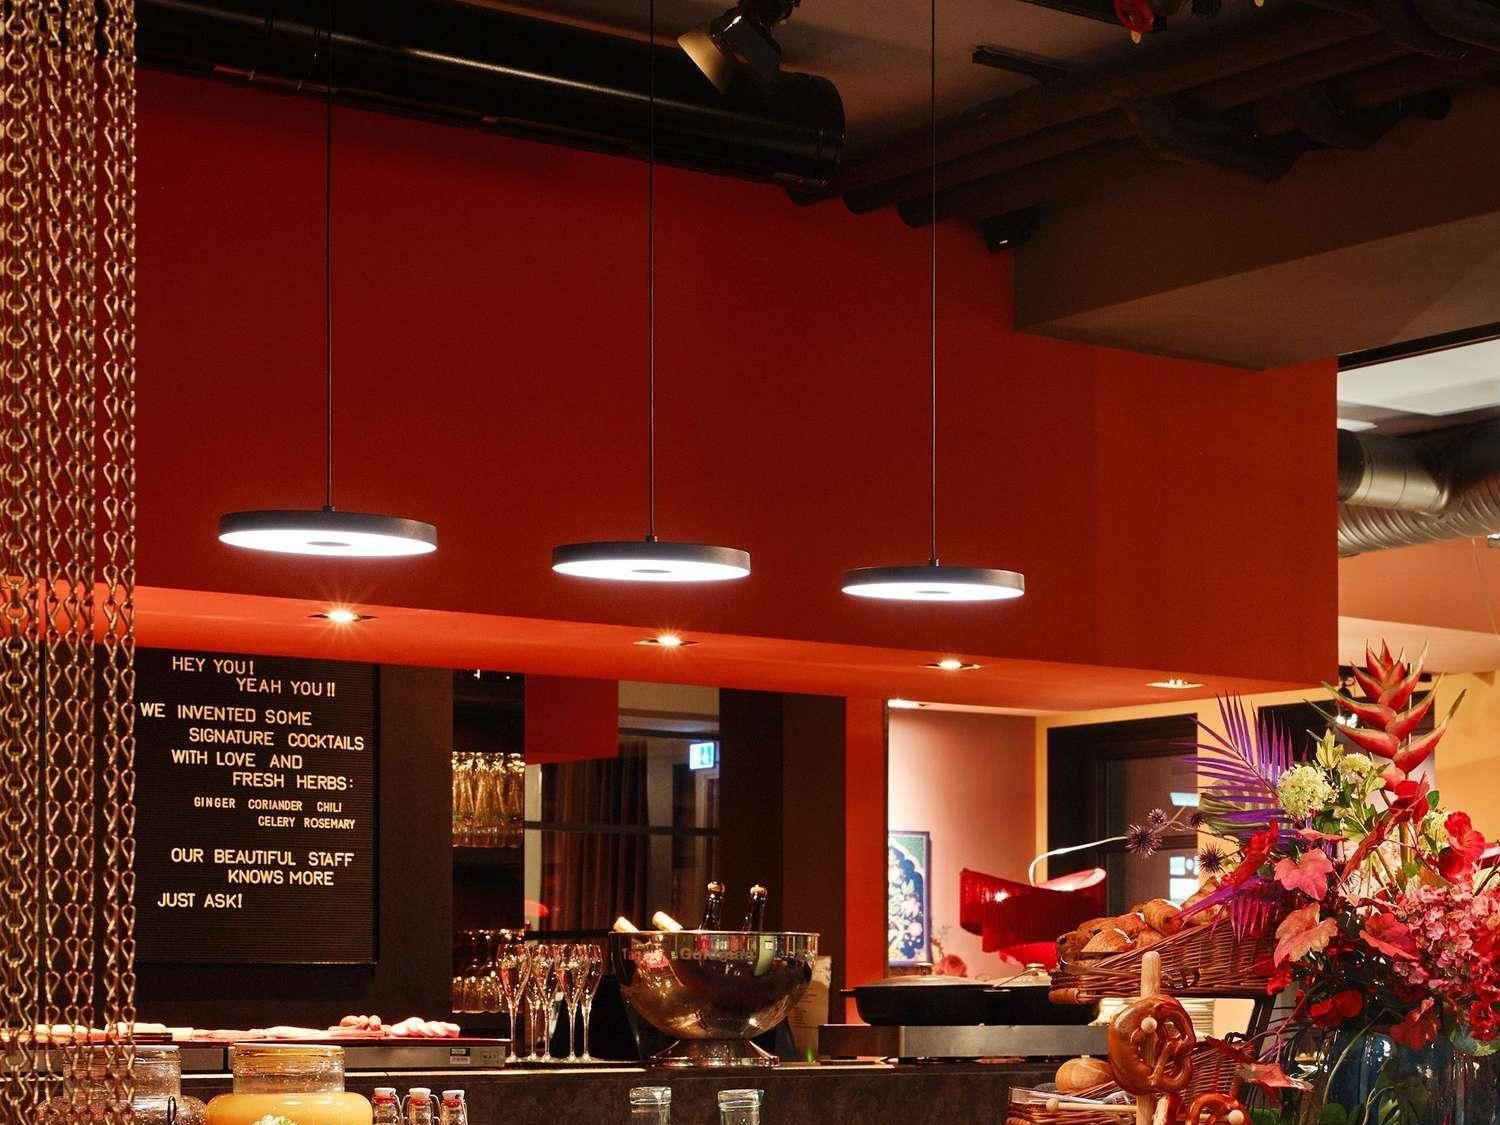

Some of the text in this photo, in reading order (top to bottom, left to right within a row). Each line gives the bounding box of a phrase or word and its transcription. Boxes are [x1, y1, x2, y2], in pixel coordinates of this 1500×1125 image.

[172, 655, 206, 673] HEY
[235, 677, 282, 694] YEAH
[139, 701, 313, 726] WE INVENTED SOME
[188, 727, 365, 751] SIGNATURE COCKTAILS
[170, 748, 303, 770] WITH LOVE AND
[232, 771, 354, 791] FRESH HERBS:
[193, 796, 342, 813] GINGER CORIANDER CHILI
[257, 815, 356, 830] CELERY ROSEMARY
[170, 847, 355, 867] OUR BEAUTIFUL STAFF
[227, 869, 335, 886] KNOWS MORE
[157, 892, 243, 909] JUST ASK!
